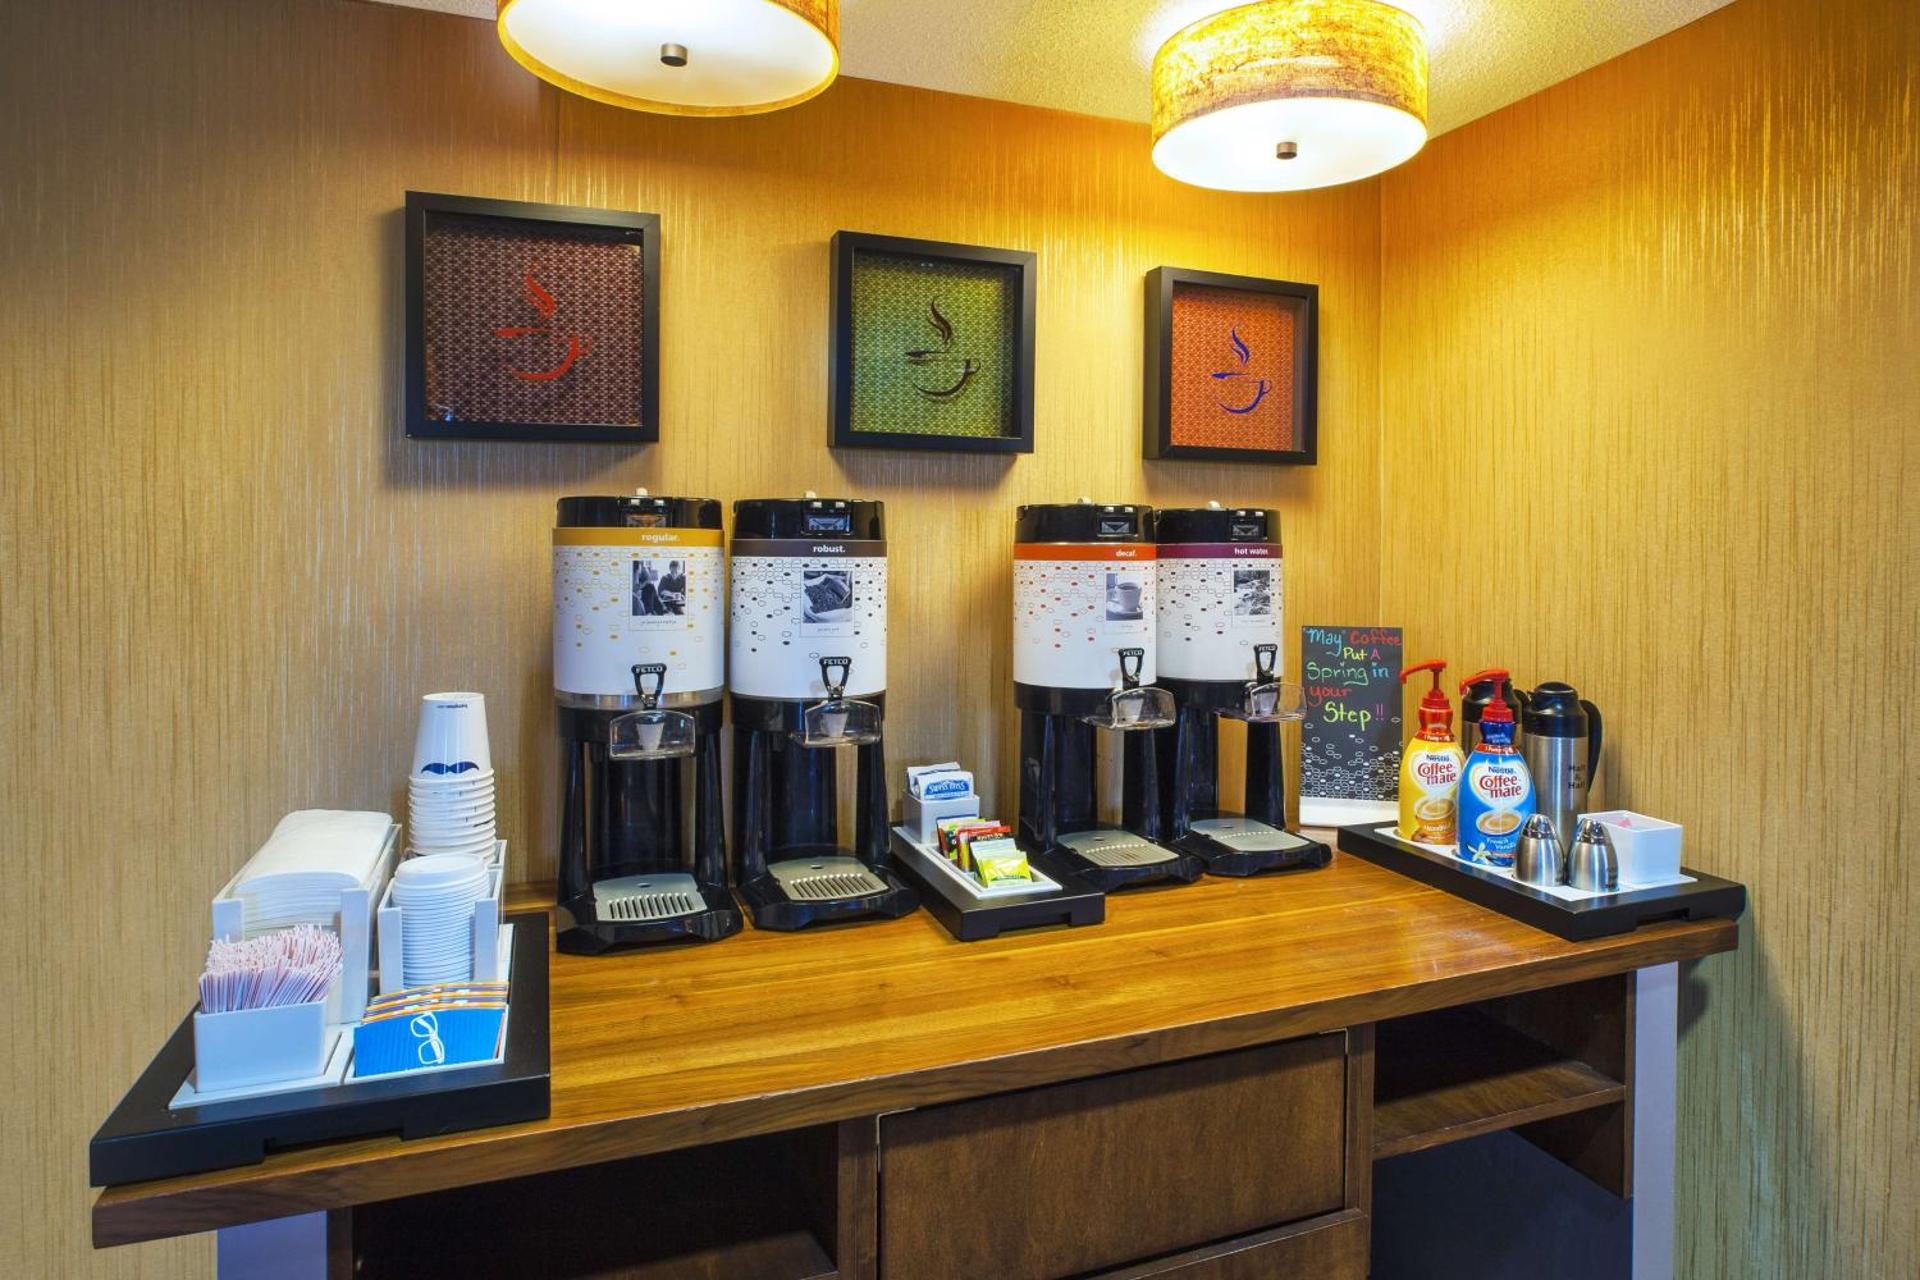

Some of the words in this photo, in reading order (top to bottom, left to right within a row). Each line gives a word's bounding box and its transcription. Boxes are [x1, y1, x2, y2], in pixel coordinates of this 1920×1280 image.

[1234, 547, 1248, 555] hot
[1306, 628, 1342, 657] May
[1349, 628, 1402, 646] Coffee
[1343, 647, 1368, 660] Put
[1370, 648, 1381, 660] A
[1306, 661, 1369, 686] Spring
[1371, 661, 1390, 678] in
[1308, 686, 1352, 706] your
[1323, 701, 1371, 731] Step
[1427, 772, 1457, 785] mate
[1490, 785, 1522, 799] mate
